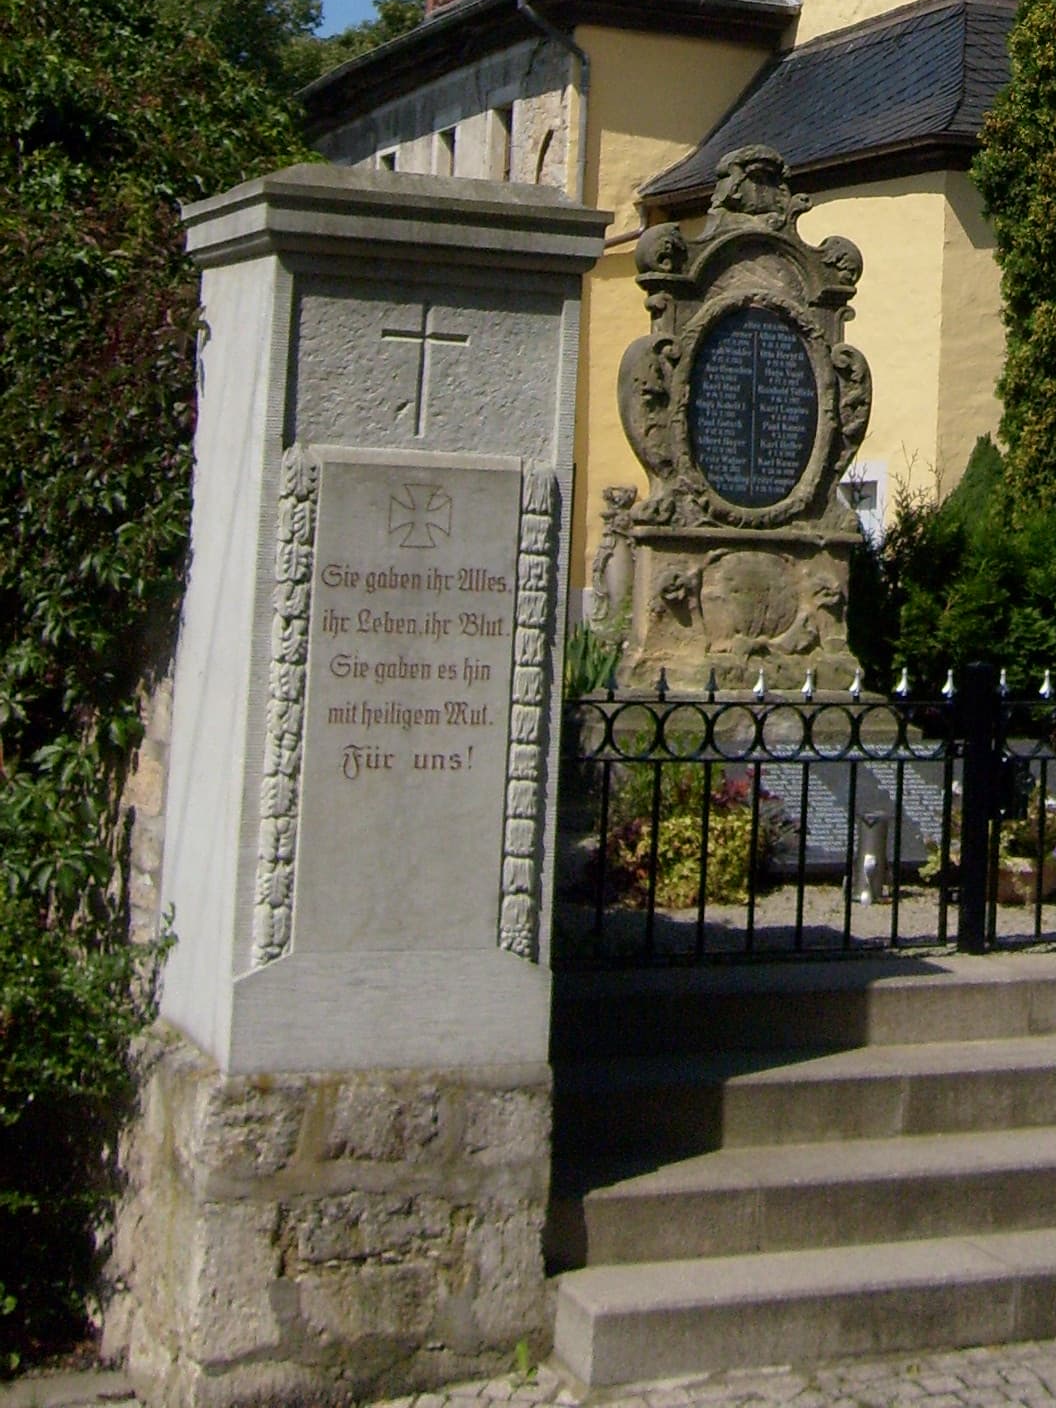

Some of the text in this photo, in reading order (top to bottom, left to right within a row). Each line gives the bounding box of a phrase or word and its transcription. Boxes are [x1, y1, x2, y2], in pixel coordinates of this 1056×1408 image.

[320, 563, 360, 589] Sie
[365, 566, 422, 593] gaben
[426, 567, 454, 595] ihr
[321, 609, 351, 639] ihr
[423, 610, 452, 640] ihr
[328, 652, 491, 687] Sie gaben es hin
[327, 701, 493, 732] mit heiligem Mut.
[342, 744, 474, 780] Für uns!
